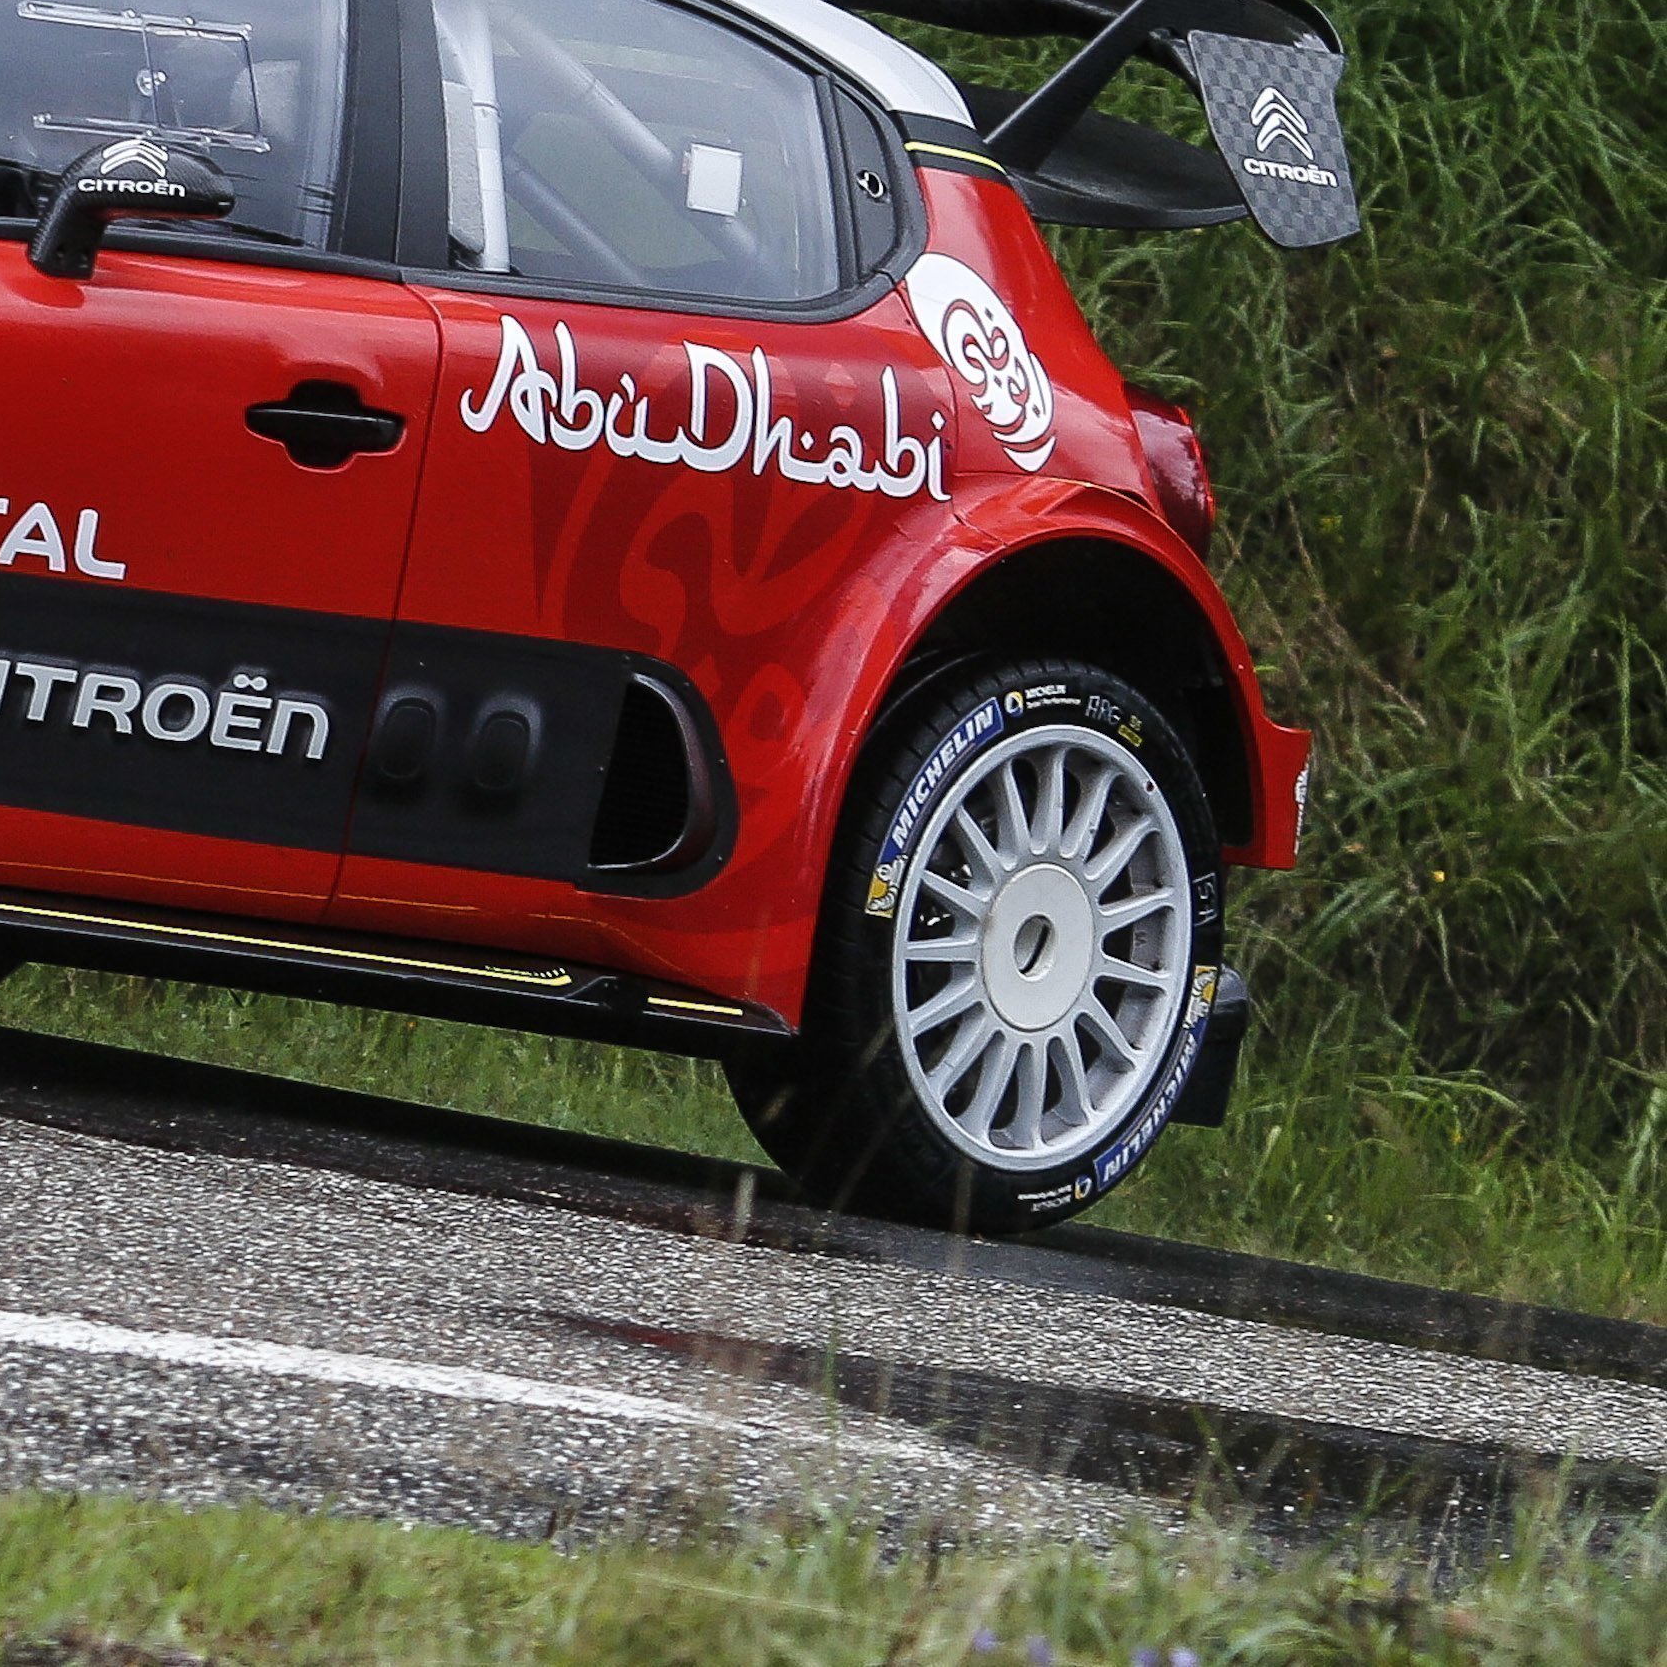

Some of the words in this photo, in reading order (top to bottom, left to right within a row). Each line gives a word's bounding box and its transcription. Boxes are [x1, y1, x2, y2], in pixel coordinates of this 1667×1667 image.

[77, 178, 186, 198] CITROËN
[1243, 157, 1339, 187] CITROËN
[893, 705, 995, 848] MICHELIN
[1103, 1033, 1197, 1183] MICHELIN
